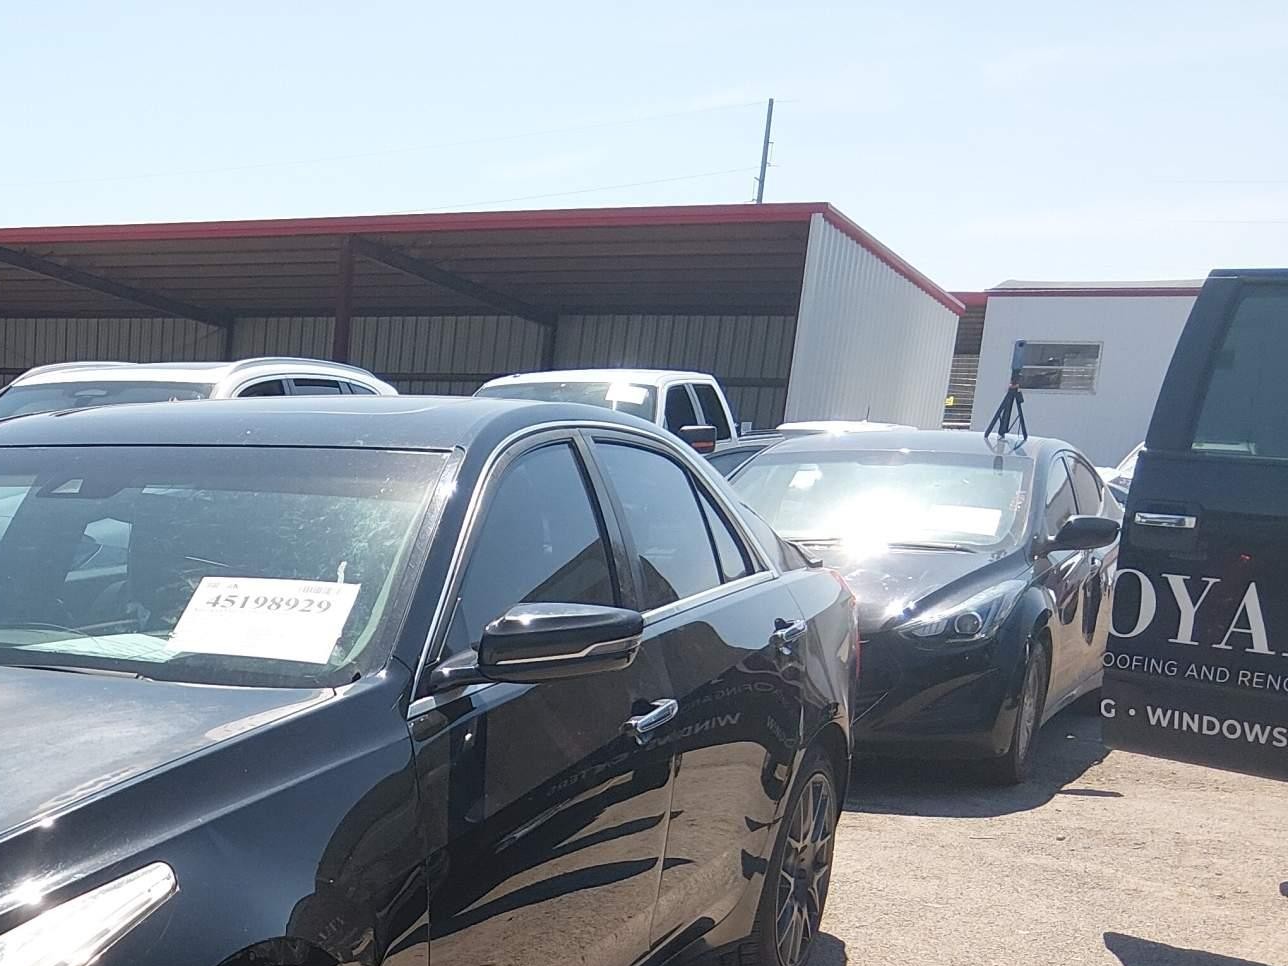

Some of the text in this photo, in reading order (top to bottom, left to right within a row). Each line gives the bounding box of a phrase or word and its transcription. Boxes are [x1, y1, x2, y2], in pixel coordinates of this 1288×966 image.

[206, 594, 332, 613] 45198929
[1108, 568, 1288, 656] OYA
[1184, 663, 1231, 683] AND
[1146, 705, 1288, 748] WINDOWS
